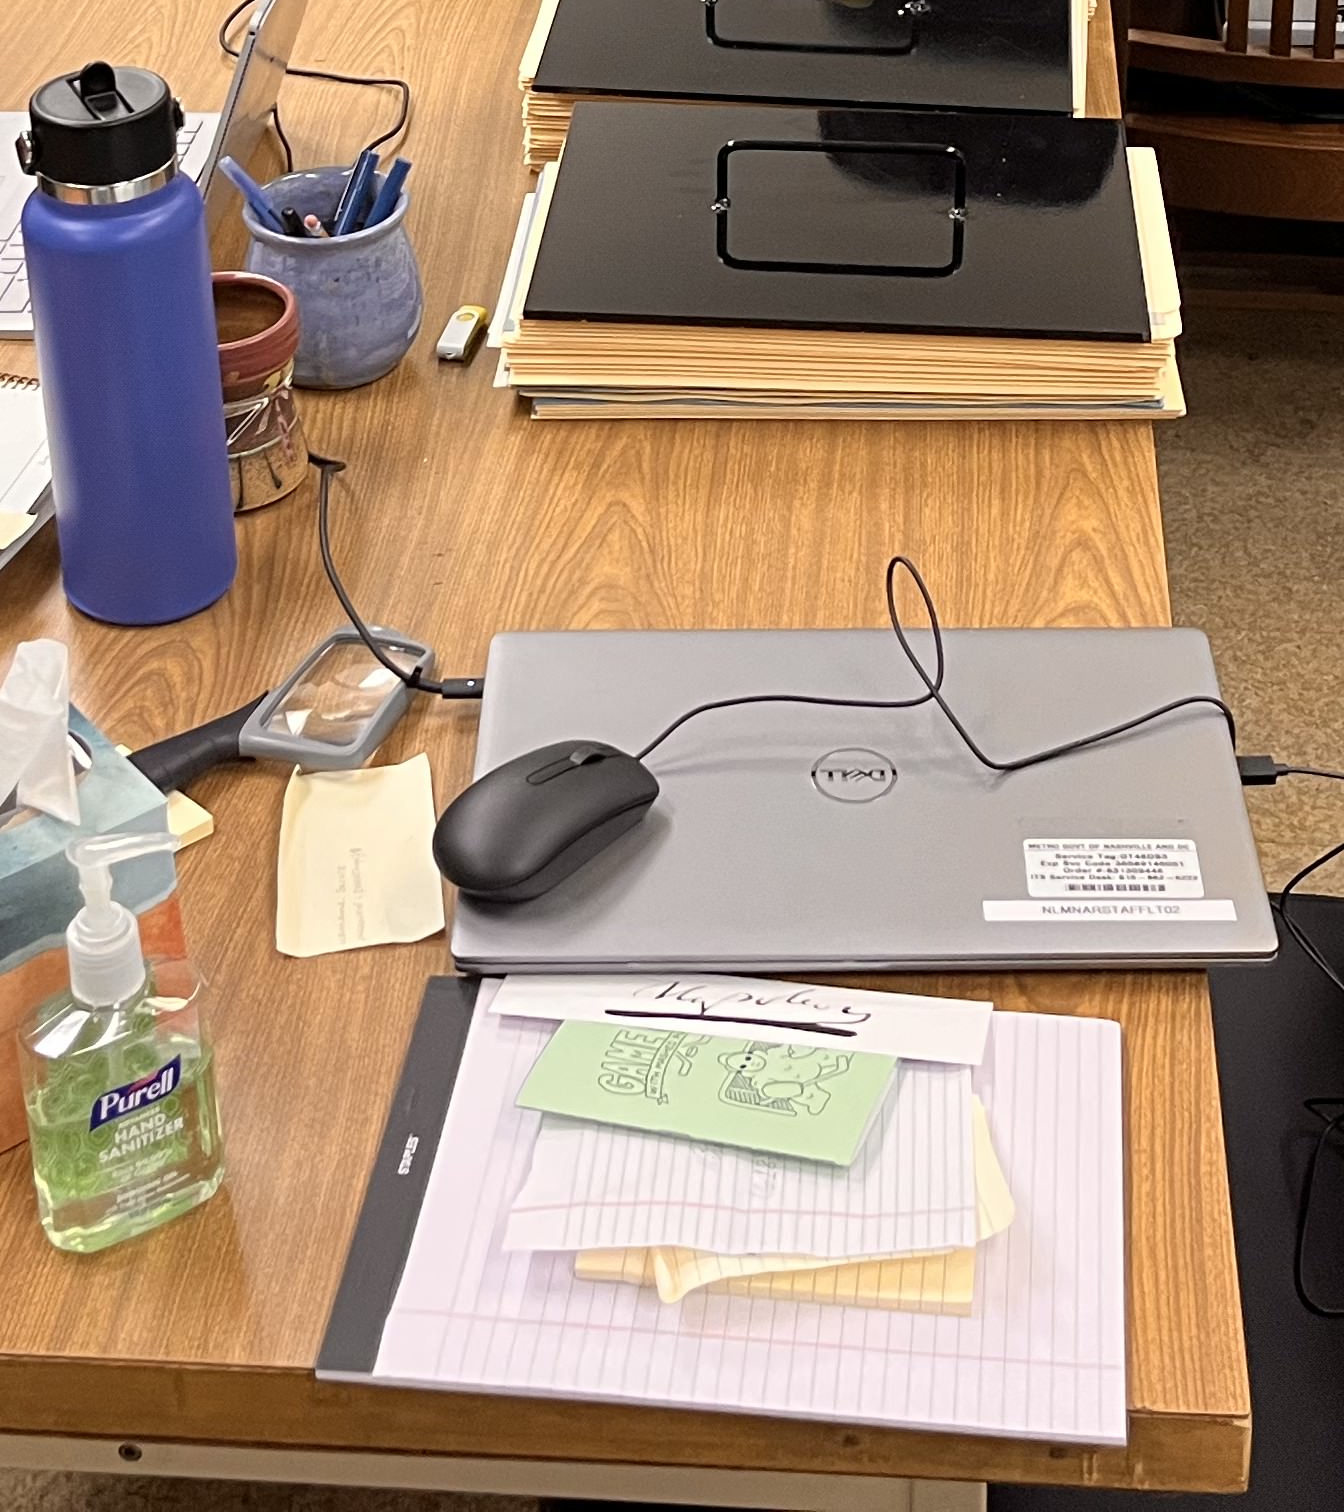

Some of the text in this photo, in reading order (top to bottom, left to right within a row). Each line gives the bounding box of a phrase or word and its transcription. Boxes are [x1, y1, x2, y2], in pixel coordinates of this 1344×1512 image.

[597, 1028, 660, 1096] GAME
[100, 1067, 175, 1121] Purell
[98, 1116, 184, 1163] SANITIZER
[114, 1113, 167, 1144] HAND
